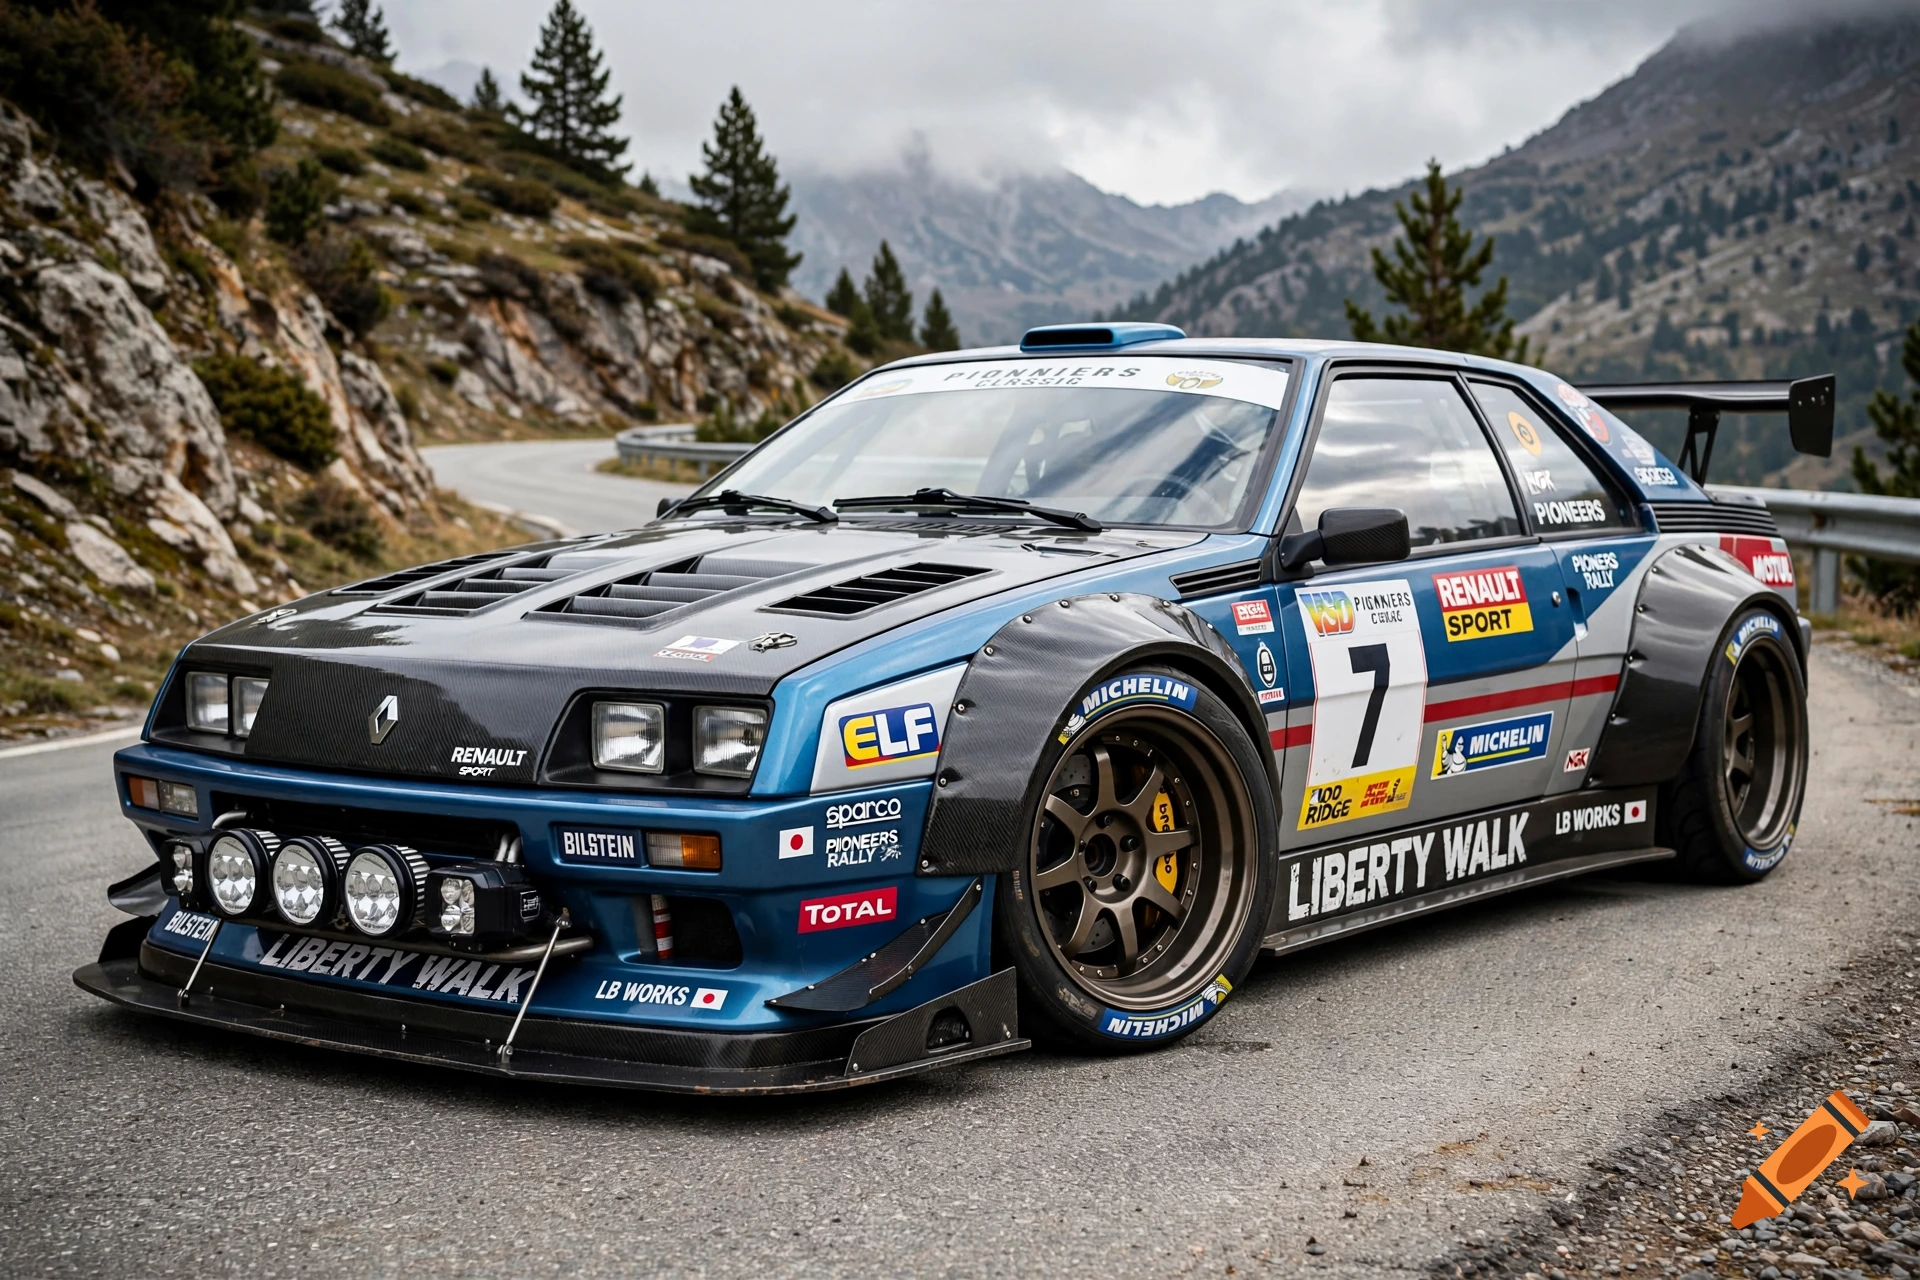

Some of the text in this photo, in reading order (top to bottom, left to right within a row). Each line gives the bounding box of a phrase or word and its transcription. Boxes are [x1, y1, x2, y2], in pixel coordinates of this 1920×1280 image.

[1533, 499, 1606, 525] PIONEERS
[1436, 570, 1522, 608] RENAULT
[1448, 609, 1512, 636] SPORT
[1082, 677, 1189, 714] MICHELIN
[1348, 643, 1390, 769] 7
[843, 706, 934, 761] ELF
[1469, 724, 1545, 755] MICHELIN
[451, 747, 527, 766] RENAULT
[459, 766, 496, 777] SPORT
[826, 798, 901, 828] sparco
[1305, 799, 1353, 826] RIDGE
[1556, 804, 1620, 835] LB WORKS
[563, 831, 635, 858] BILSTEIN
[1159, 803, 1173, 874] brebo
[827, 848, 877, 868] RALLY
[1288, 812, 1530, 921] LIBERTY WALK
[164, 911, 218, 942] BILSTEIN
[804, 898, 892, 925] TOTAL
[259, 934, 538, 1004] LIBERTY WALK
[595, 980, 690, 1006] LB WORKS
[1107, 1001, 1205, 1037] MICHELIN
